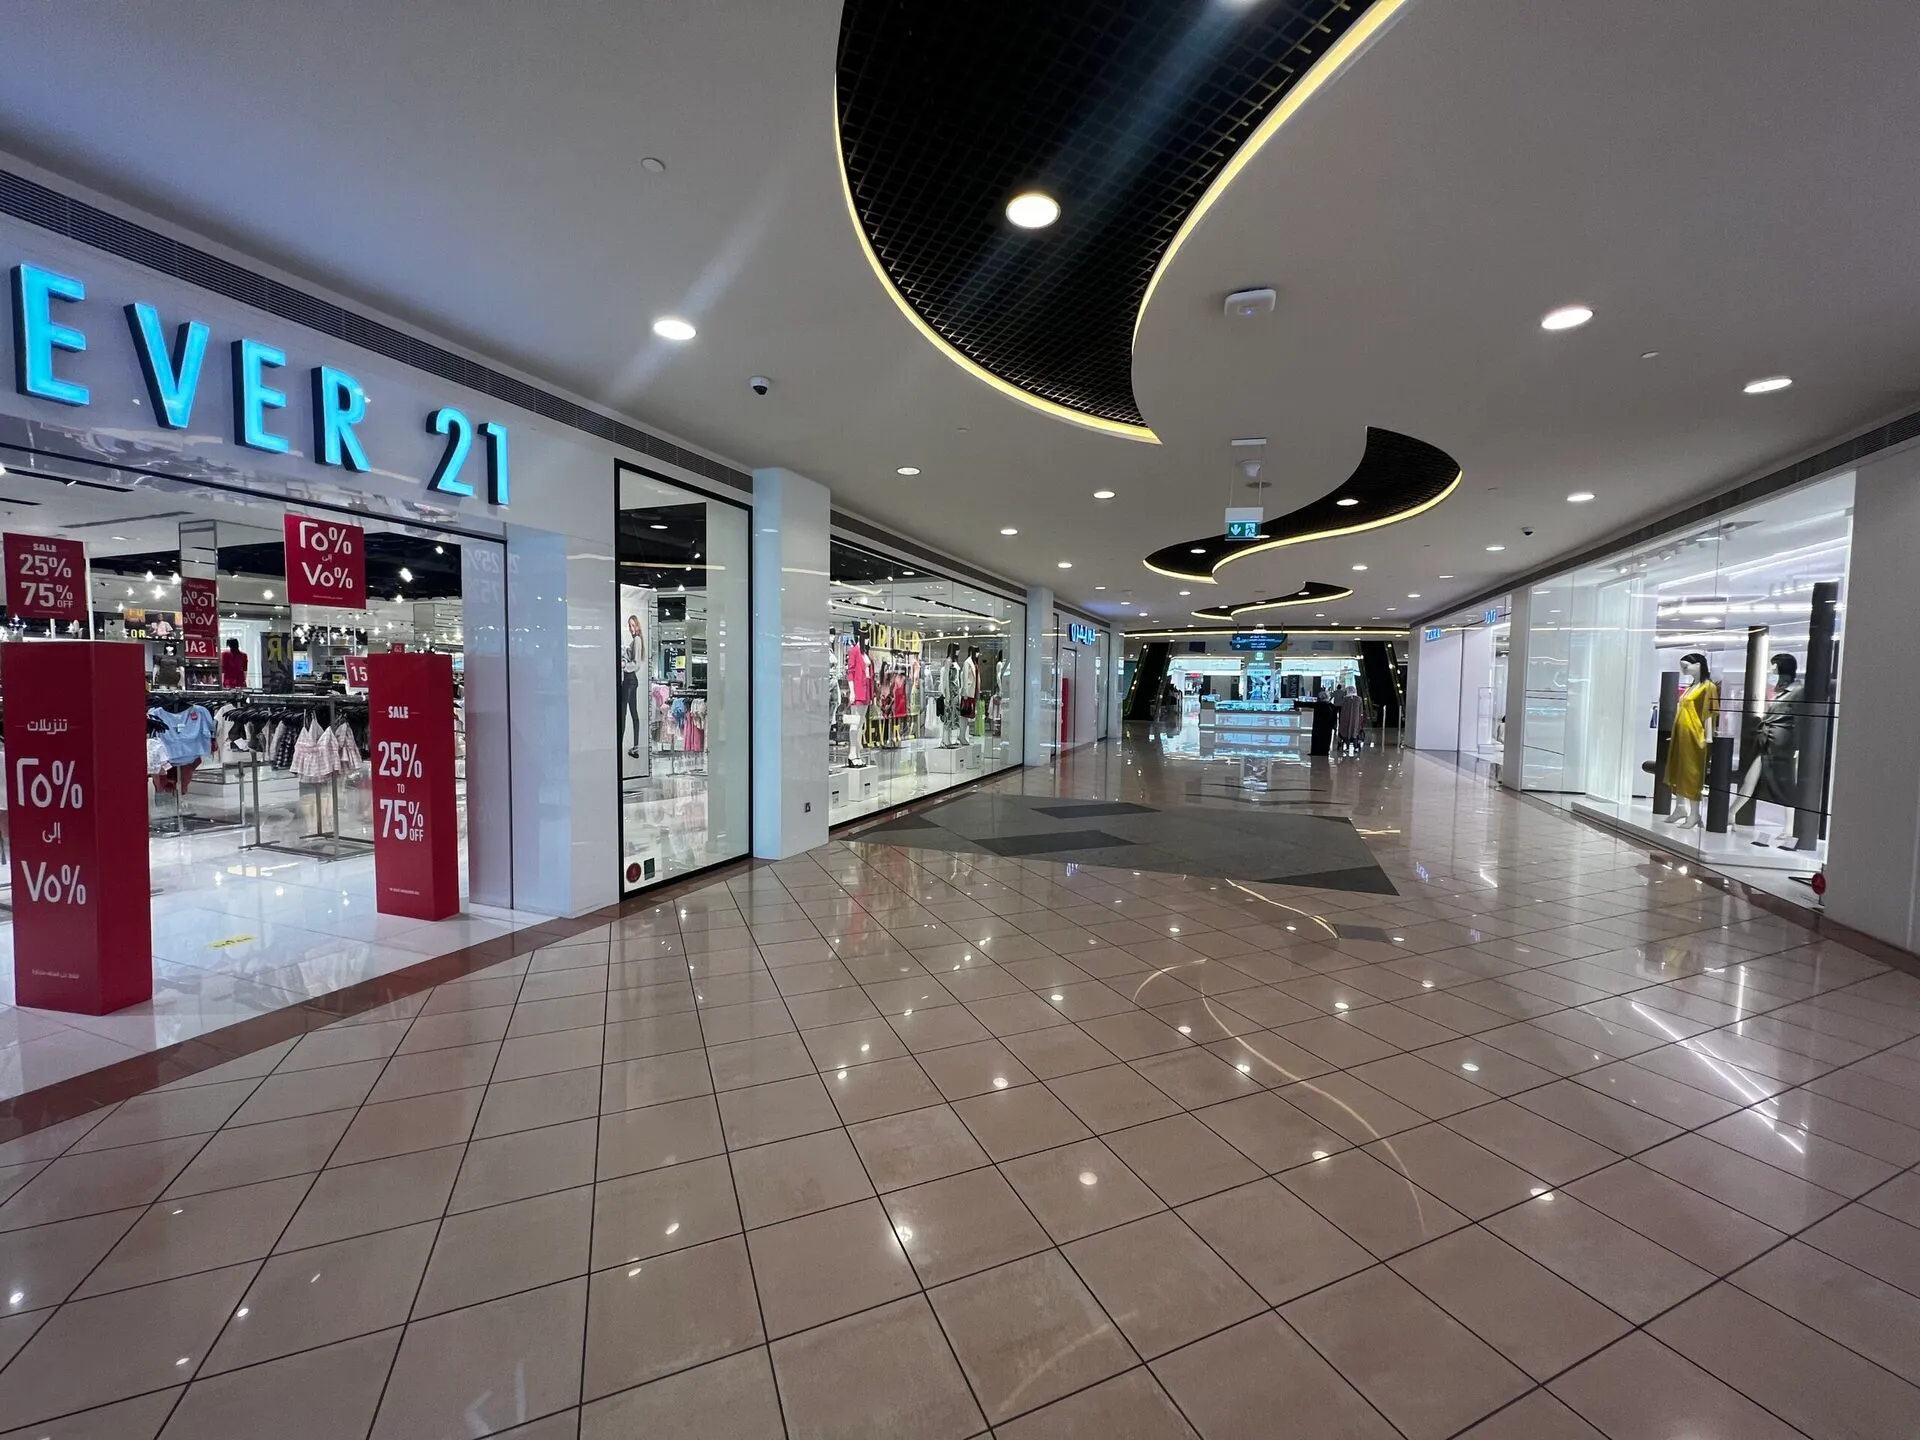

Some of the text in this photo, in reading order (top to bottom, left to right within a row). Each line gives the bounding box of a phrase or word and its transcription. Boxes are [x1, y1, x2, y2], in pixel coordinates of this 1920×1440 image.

[12, 263, 511, 505] EVER 21
[33, 543, 57, 553] SALE
[19, 553, 72, 578] 25%
[20, 581, 73, 607] 75%
[57, 600, 74, 608] OFF
[387, 705, 409, 719] SALE
[27, 718, 68, 735] تنزيلات
[378, 740, 422, 779] 25%
[397, 783, 405, 794] TO
[379, 798, 424, 841] 75%
[42, 821, 61, 844] إلى
[409, 828, 424, 842] OFF
